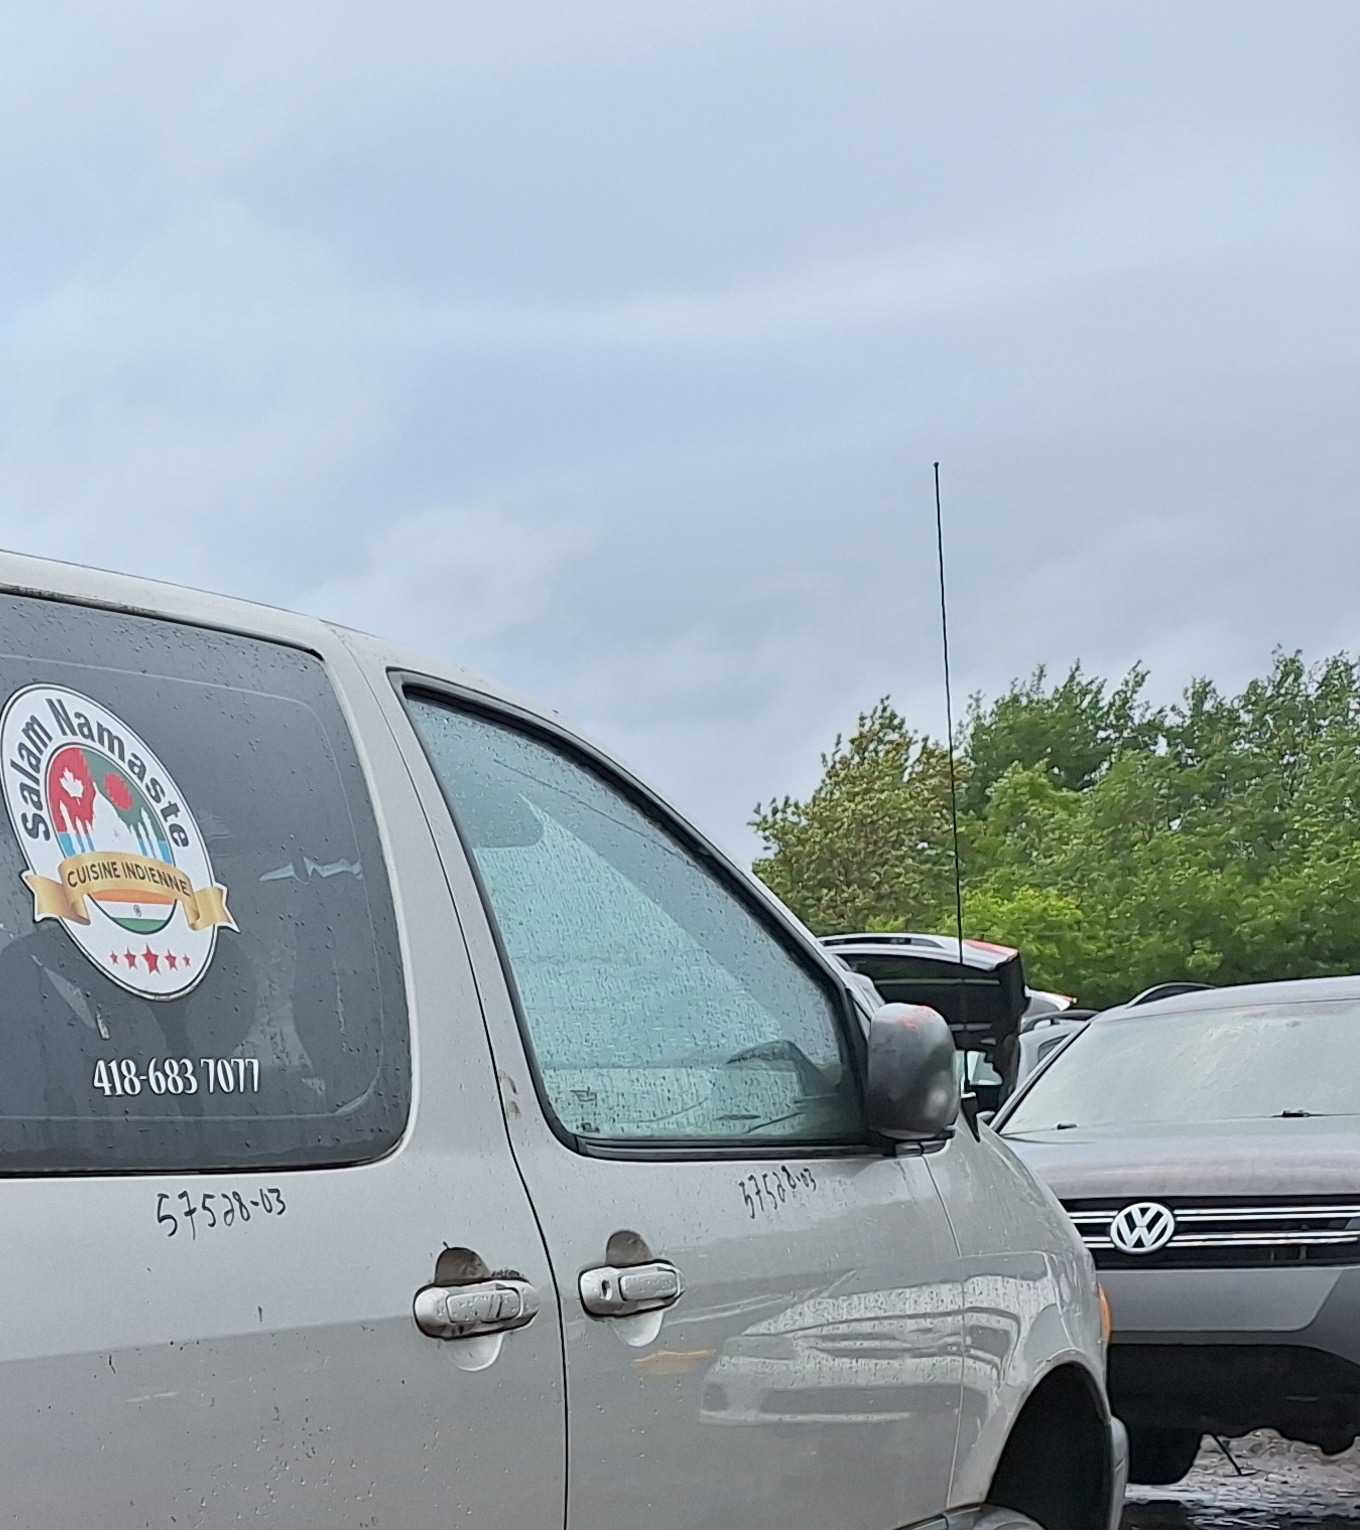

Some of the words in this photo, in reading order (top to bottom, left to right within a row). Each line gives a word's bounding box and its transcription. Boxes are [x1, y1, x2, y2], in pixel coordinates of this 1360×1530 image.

[10, 713, 53, 842] Salam
[44, 697, 190, 849] Namaste
[66, 860, 121, 888] CUISINE
[121, 861, 192, 897] INDIENNE
[156, 1187, 287, 1241] 57528-03
[1116, 1204, 1171, 1251] VW
